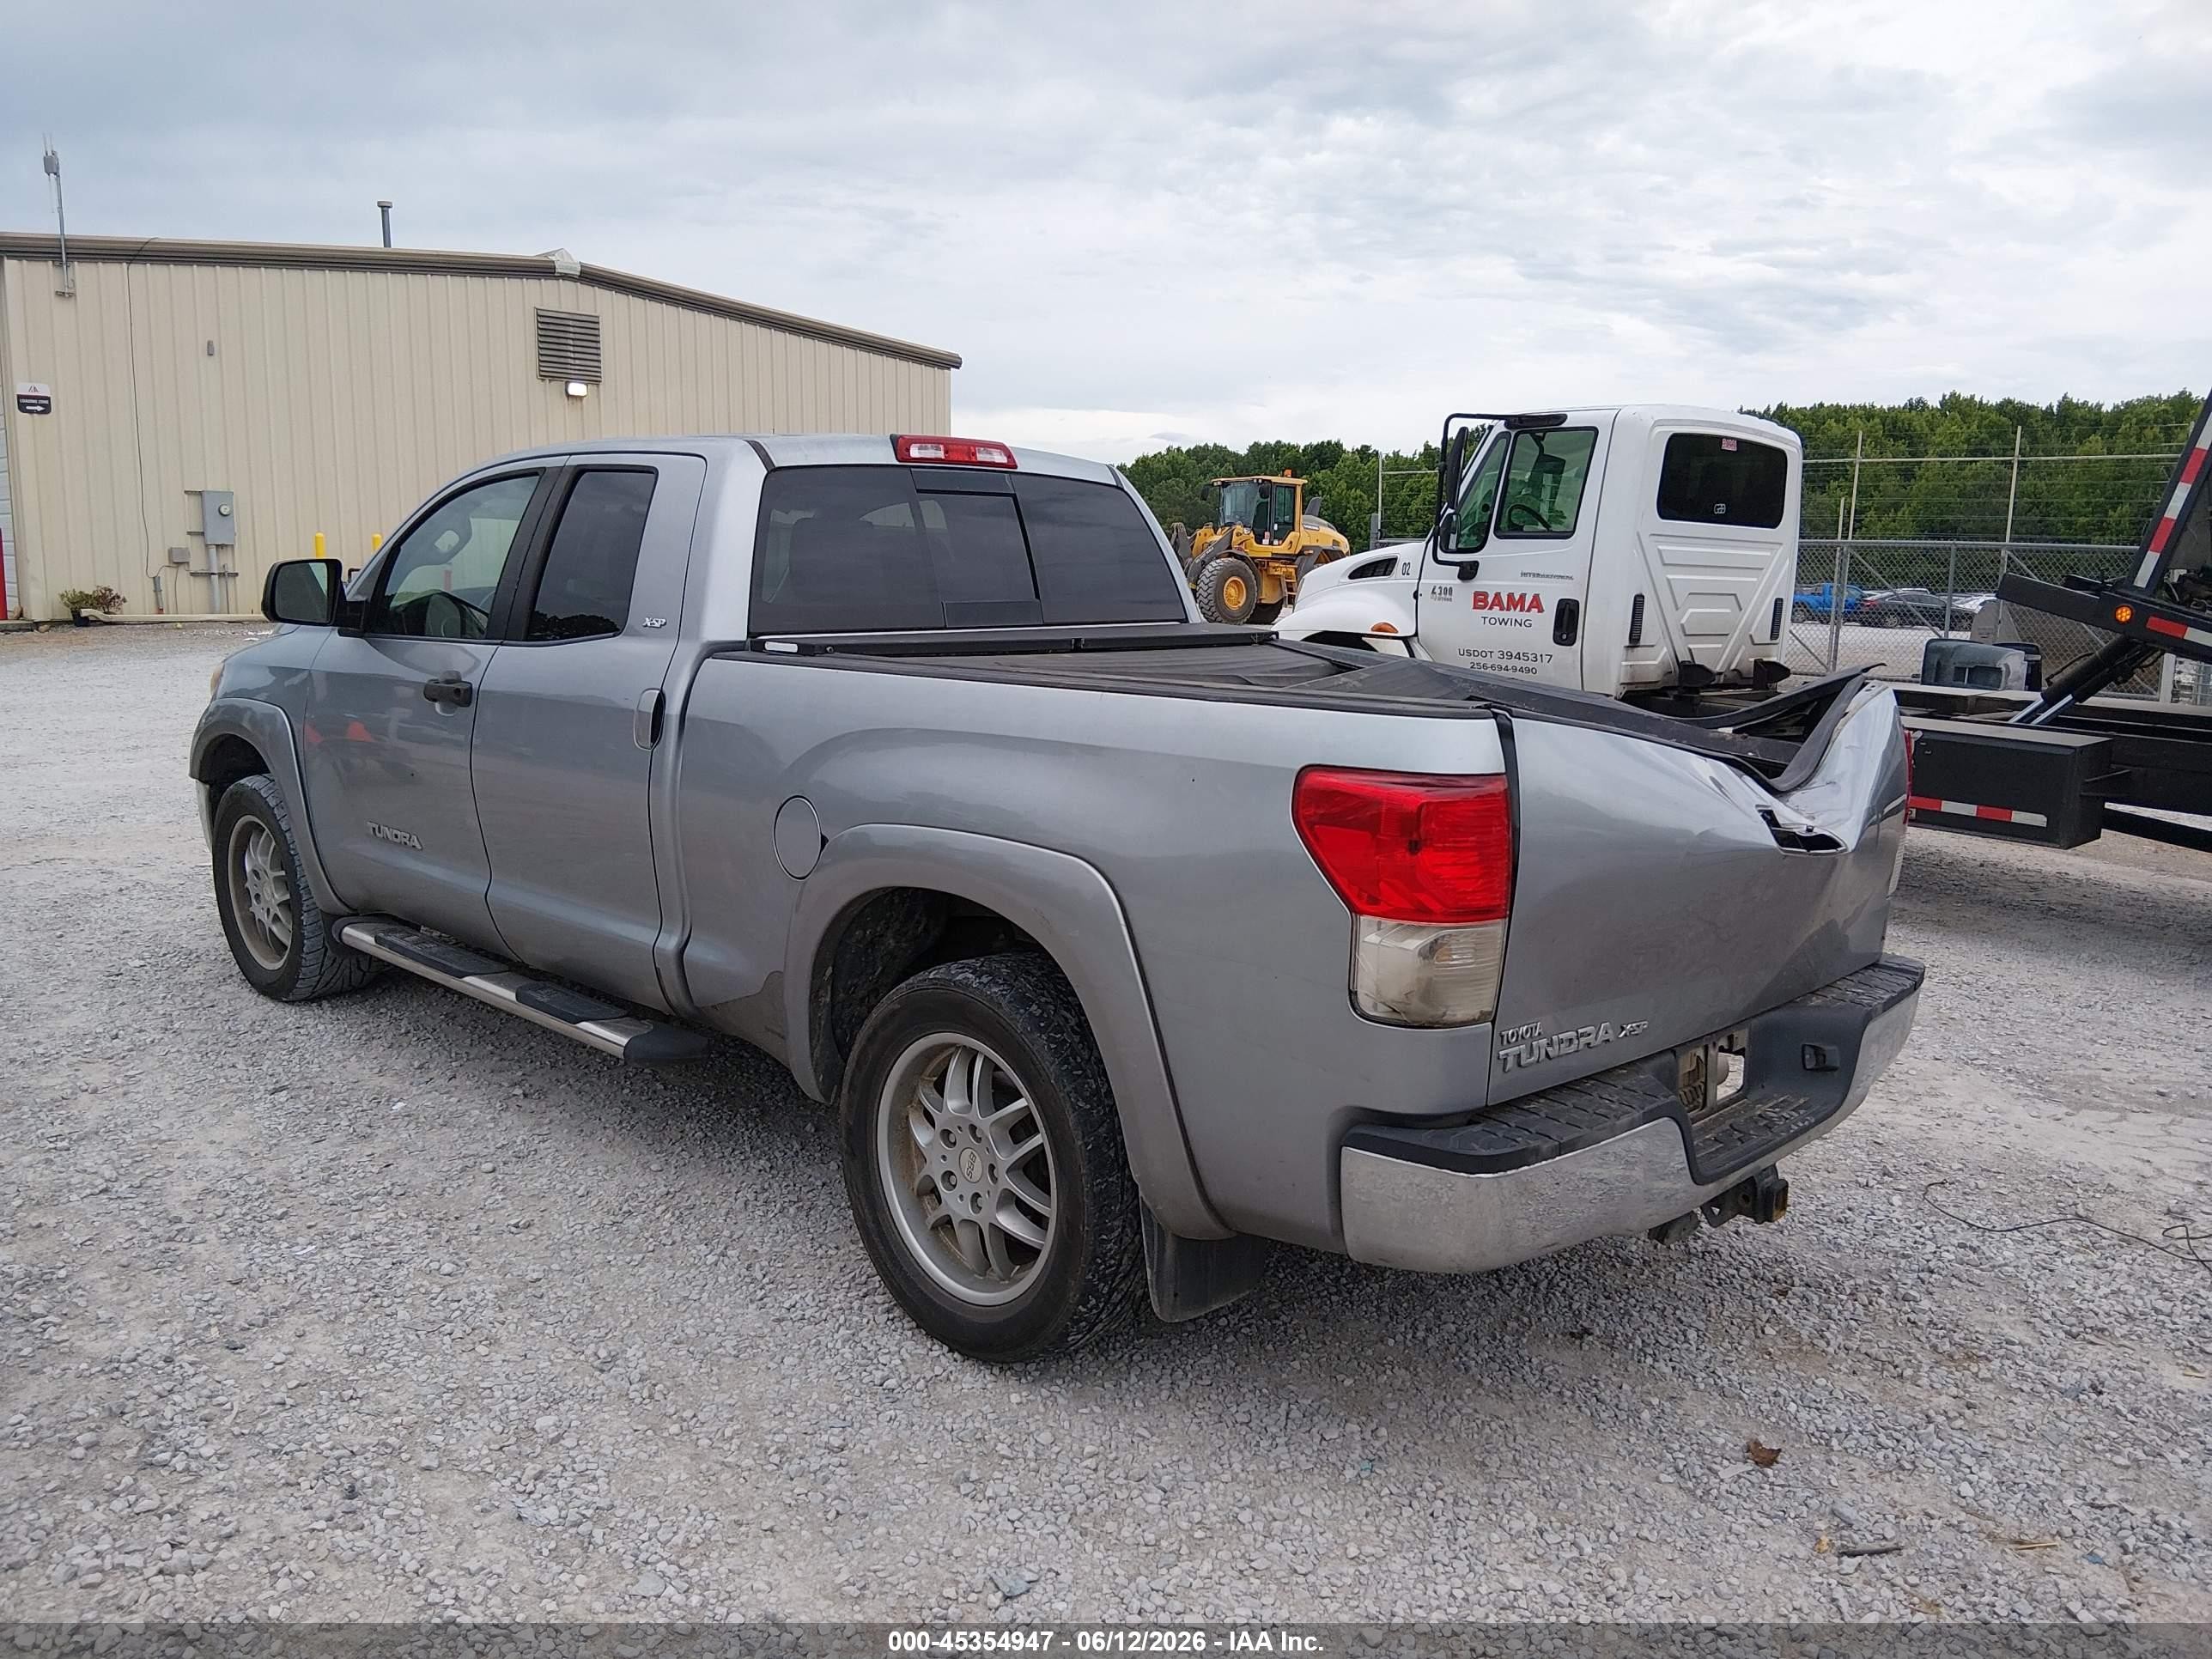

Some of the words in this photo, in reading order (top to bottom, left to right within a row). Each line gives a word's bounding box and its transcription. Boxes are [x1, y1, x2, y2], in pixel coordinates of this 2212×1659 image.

[1401, 562, 1411, 576] 02
[1431, 585, 1453, 597] 4300
[1472, 591, 1545, 613] BAMA
[1481, 616, 1533, 628] TOWING
[1458, 648, 1495, 659] USDOT
[1497, 650, 1553, 664] 3945317
[1469, 661, 1538, 675] 256-694-9490
[367, 820, 423, 850] TUNDRA
[1500, 1021, 1543, 1046] TOYOTA
[1498, 1021, 1616, 1073] TUNDRA
[966, 1152, 976, 1179] BBS
